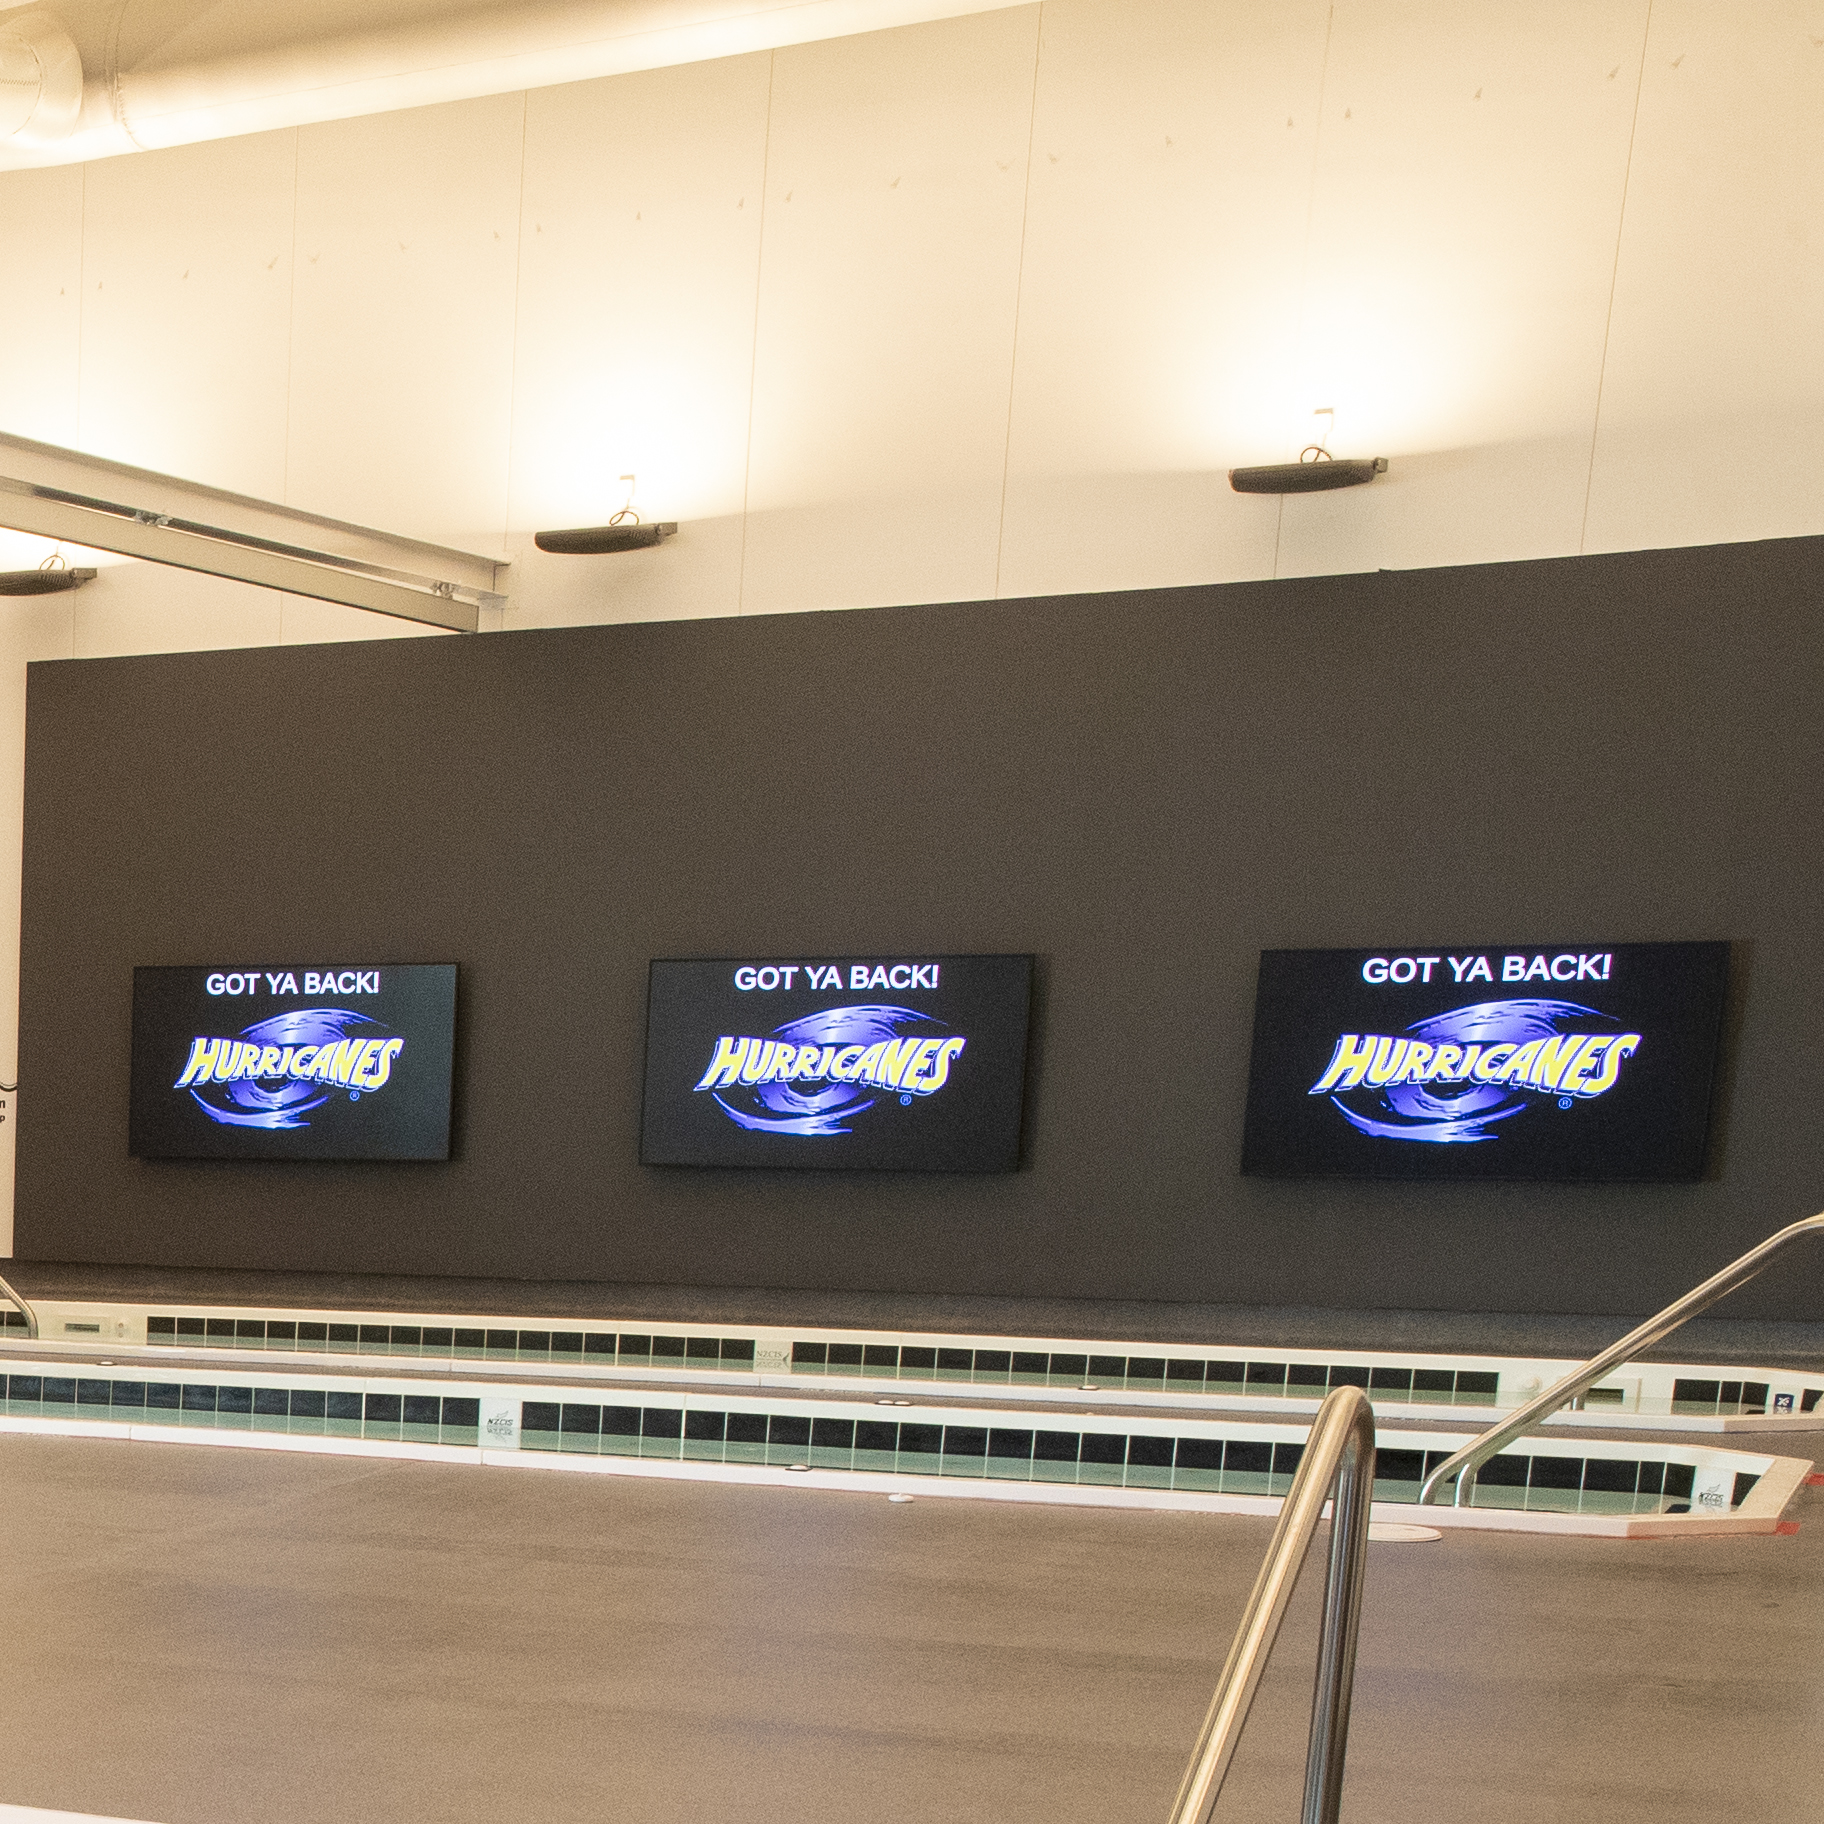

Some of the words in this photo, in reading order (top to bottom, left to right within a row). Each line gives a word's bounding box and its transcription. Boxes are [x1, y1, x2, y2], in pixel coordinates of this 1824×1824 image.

[205, 972, 262, 997] GOT
[264, 972, 299, 997] YA
[302, 970, 380, 996] BACK!
[734, 966, 800, 992] GOT
[802, 966, 842, 991] YA
[848, 964, 941, 990] BACK!
[1362, 956, 1439, 984] GOT
[1446, 956, 1494, 982] YA
[1502, 953, 1613, 982] BACK!
[173, 1034, 405, 1091] HURRICANES
[691, 1034, 968, 1096] HURRICANES
[1307, 1033, 1642, 1096] HURRICANES
